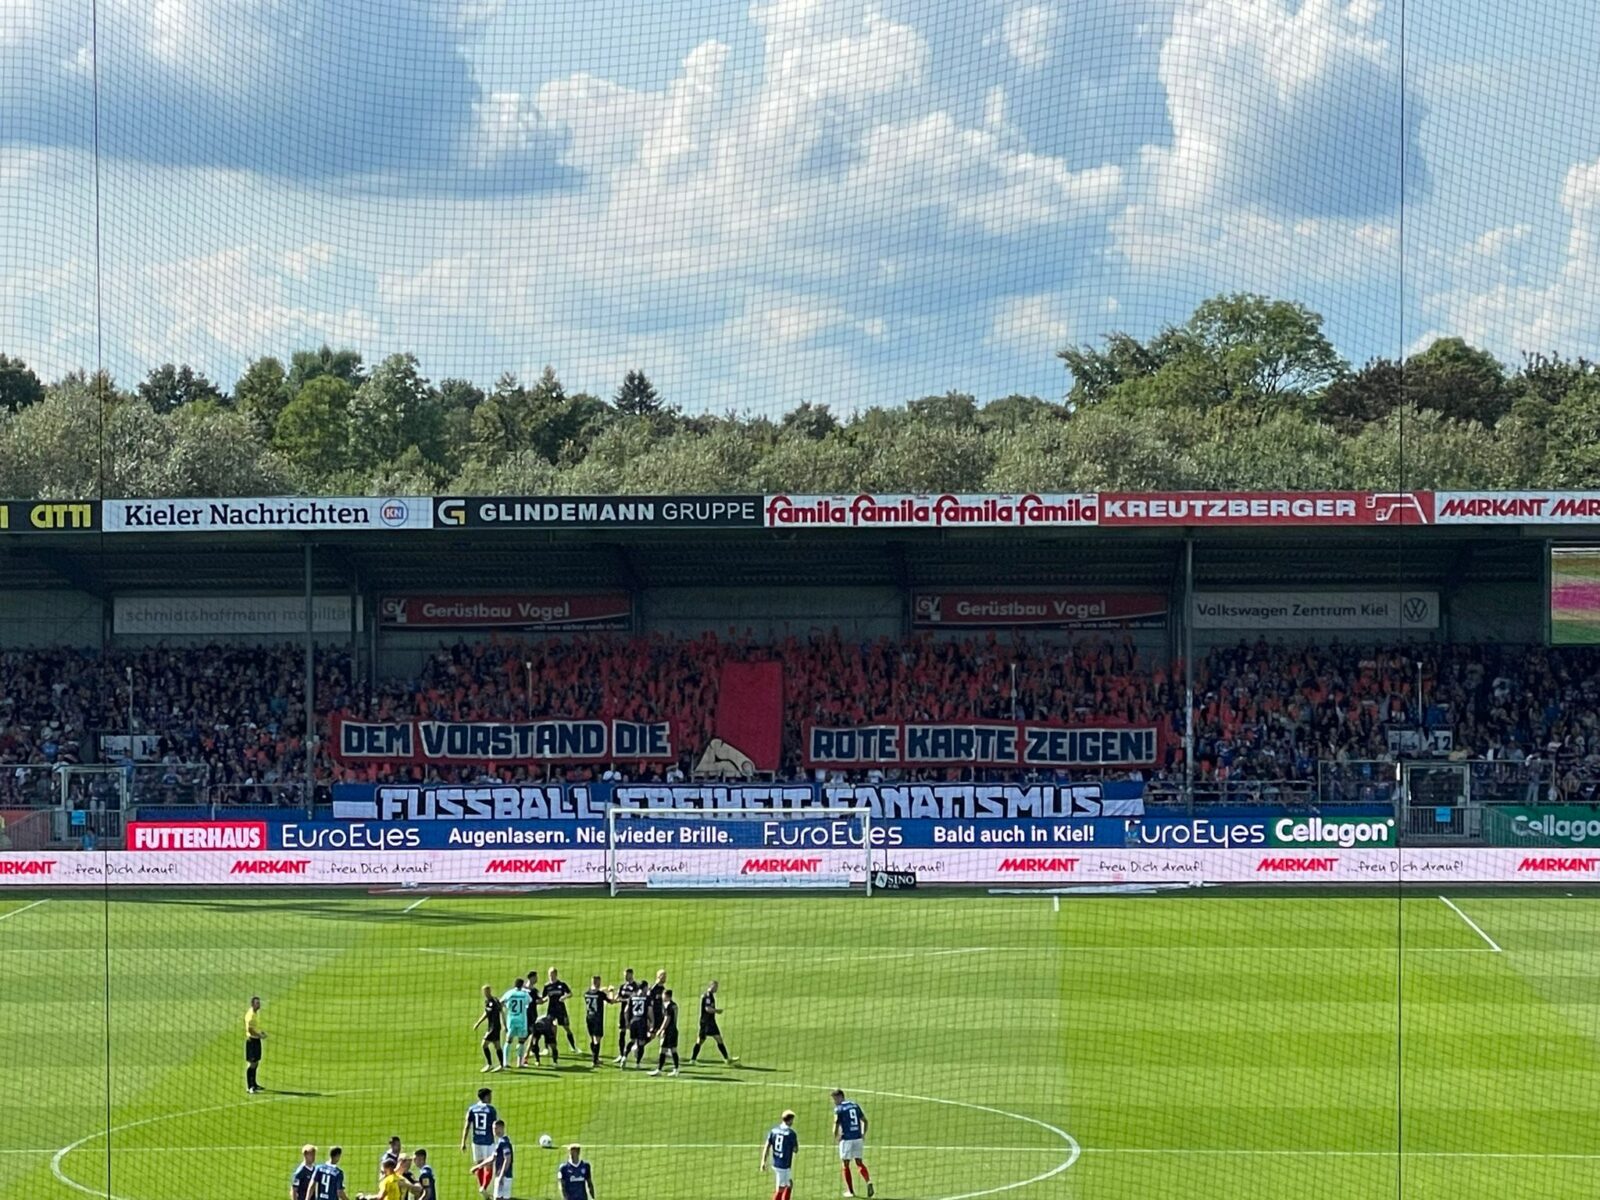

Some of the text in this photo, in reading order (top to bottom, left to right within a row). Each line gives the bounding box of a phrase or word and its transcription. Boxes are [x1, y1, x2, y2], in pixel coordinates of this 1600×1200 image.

[30, 504, 91, 528] CITTI
[125, 502, 369, 526] Kieler Nachrichten
[479, 502, 755, 521] GLINDEMANN GRUPPE
[766, 493, 1097, 527] famila famila famila famila
[1104, 499, 1356, 518] KREUTZBERGER
[1439, 498, 1550, 517] MARKANT
[422, 602, 570, 620] Gerüstbau Vogel
[956, 599, 1106, 618] Gerüstbau Vogel
[1197, 602, 1388, 619] Volkswagen Zentrum Kiel
[343, 721, 670, 756] DEM VORSTAND DIE
[813, 726, 1155, 763] ROTE KARTE ZEIGEN!
[380, 785, 1100, 820] FUSSBALL FREIHEIT FANATISMUS
[135, 827, 260, 848] FUTTERHAUS
[282, 824, 420, 850] EuroEyes
[449, 826, 734, 846] Augenlasern. Nie wieder Brille.
[933, 825, 1095, 843] Bald auch in Kiel!
[1275, 818, 1389, 847] Cellagon
[107, 863, 133, 875] Dich
[138, 863, 178, 875] drauf!
[230, 860, 312, 874] MARKANT
[361, 862, 388, 874] Dich
[392, 862, 433, 874] drauf!
[485, 859, 567, 873] MARKANT
[616, 862, 643, 873] Dich
[647, 861, 688, 873] drauf!
[741, 858, 822, 874] MARKANT
[904, 862, 945, 873] drauf!
[997, 858, 1080, 872] MARKANT
[1131, 861, 1158, 873] Dich
[1162, 861, 1203, 872] drauf!
[1256, 858, 1339, 872] MARKANT
[1390, 861, 1418, 872] Dch
[1421, 861, 1463, 872] drauf!
[1517, 857, 1600, 871] MARKANT
[511, 999, 523, 1014] 21
[632, 1000, 645, 1016] 23
[474, 1113, 487, 1130] 13
[849, 1108, 858, 1126] 9
[774, 1134, 784, 1152] 8
[321, 1174, 331, 1193] 4
